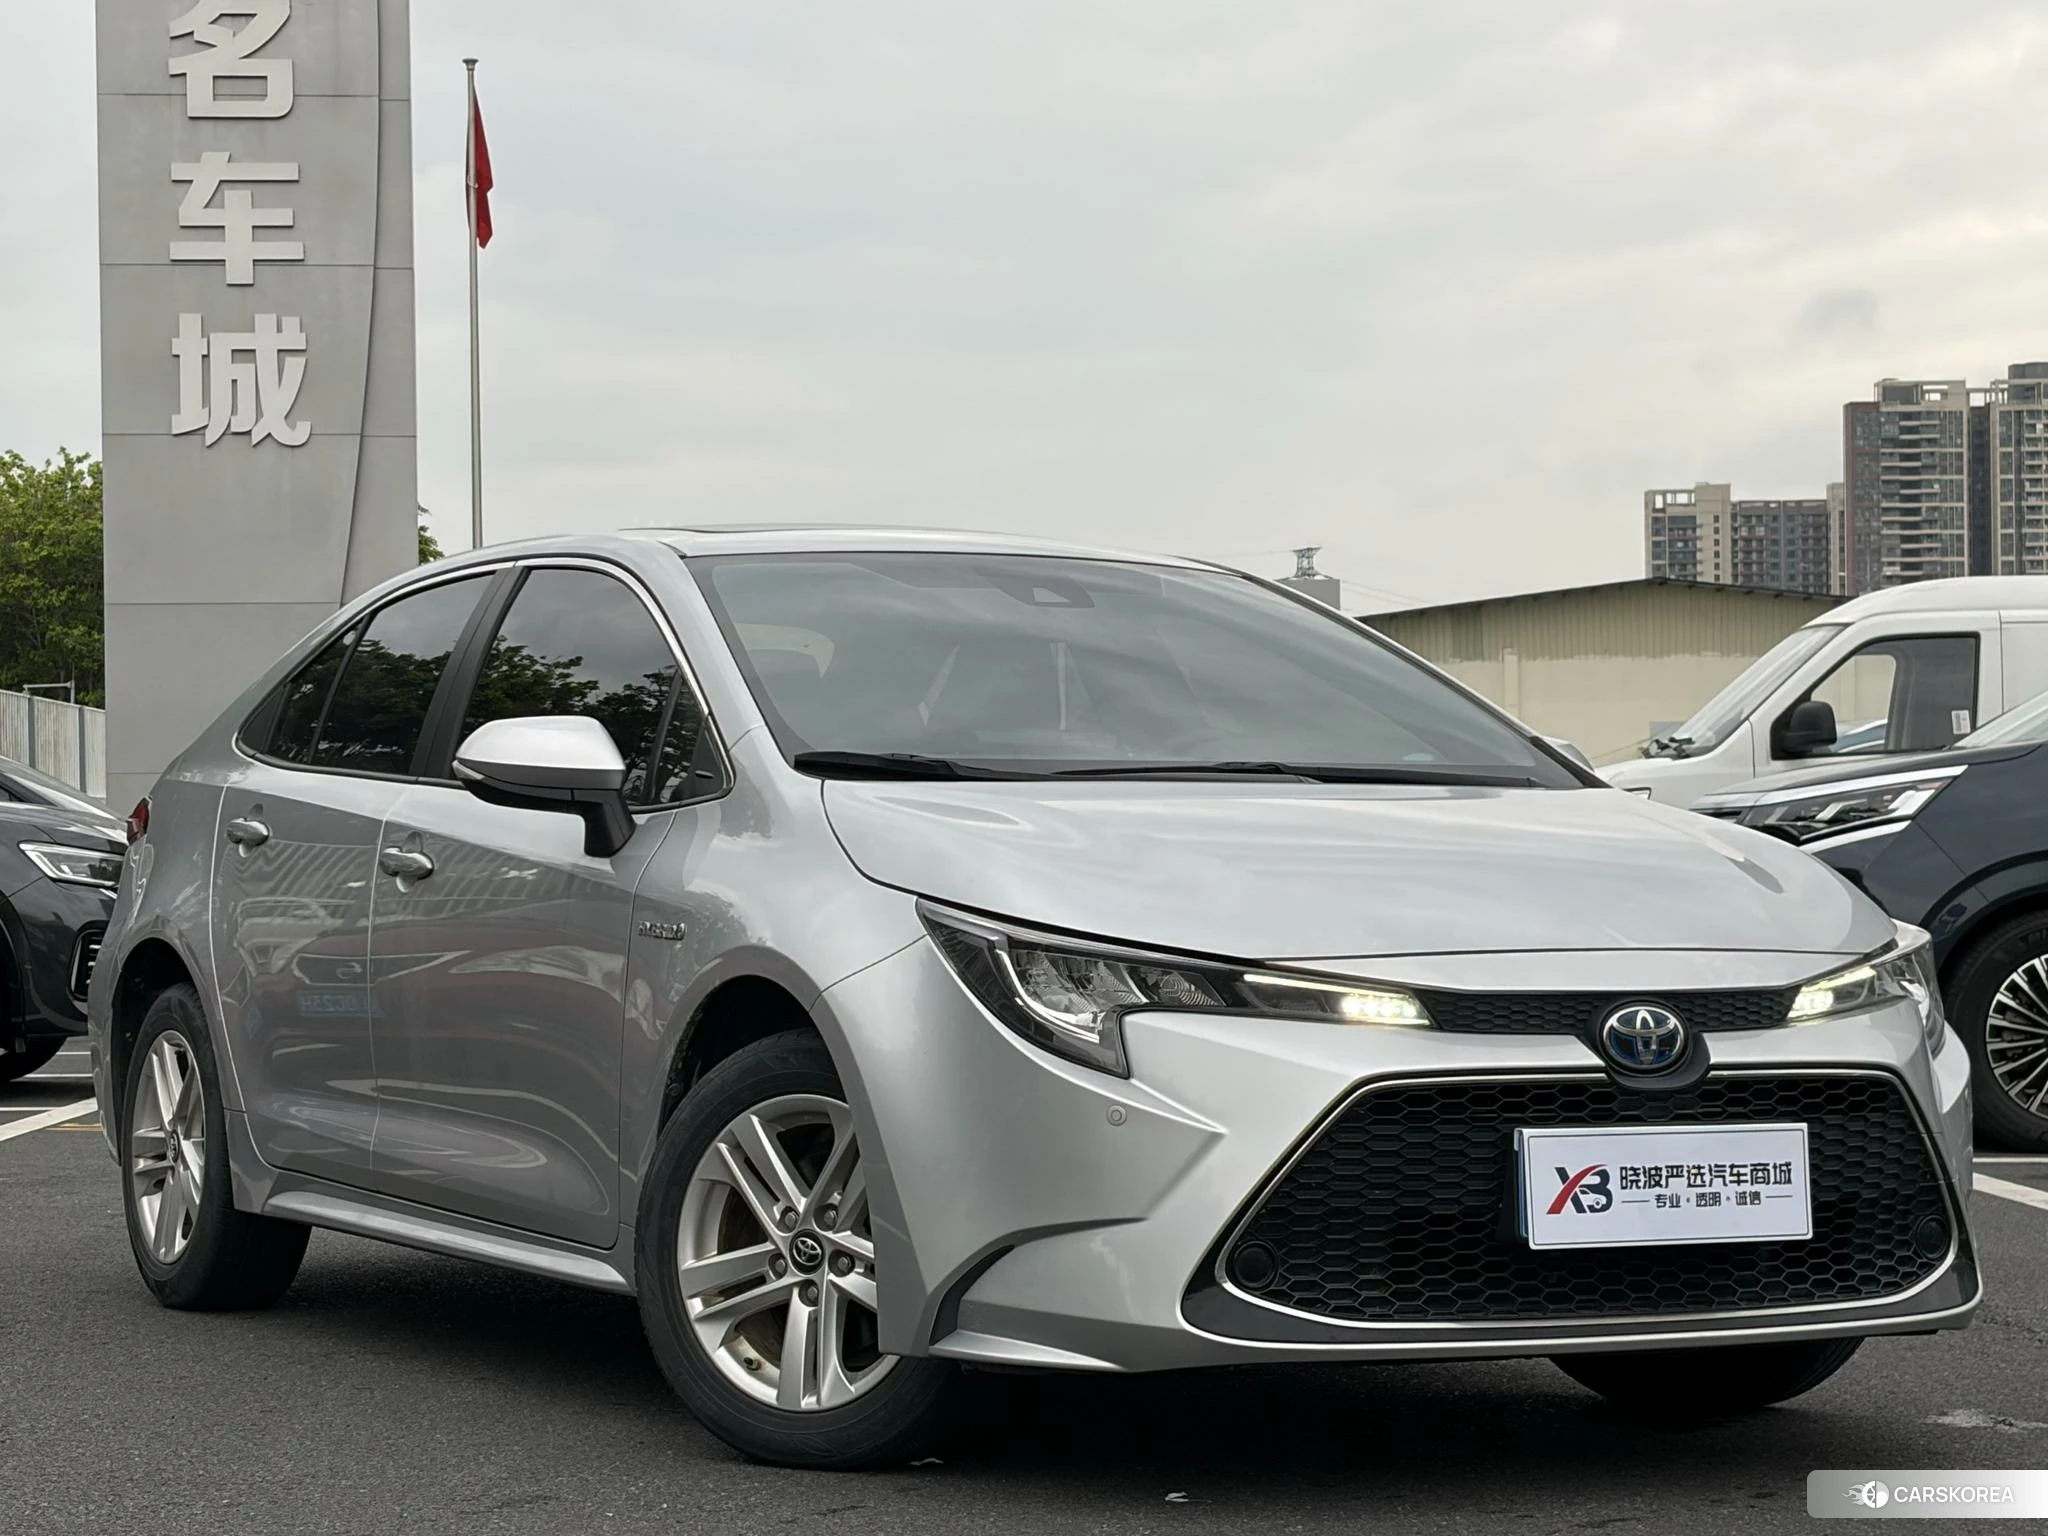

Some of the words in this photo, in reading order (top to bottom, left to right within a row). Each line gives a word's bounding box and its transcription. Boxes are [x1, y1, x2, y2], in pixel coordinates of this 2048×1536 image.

[1619, 1161, 1793, 1190] 晓波严选汽车商城
